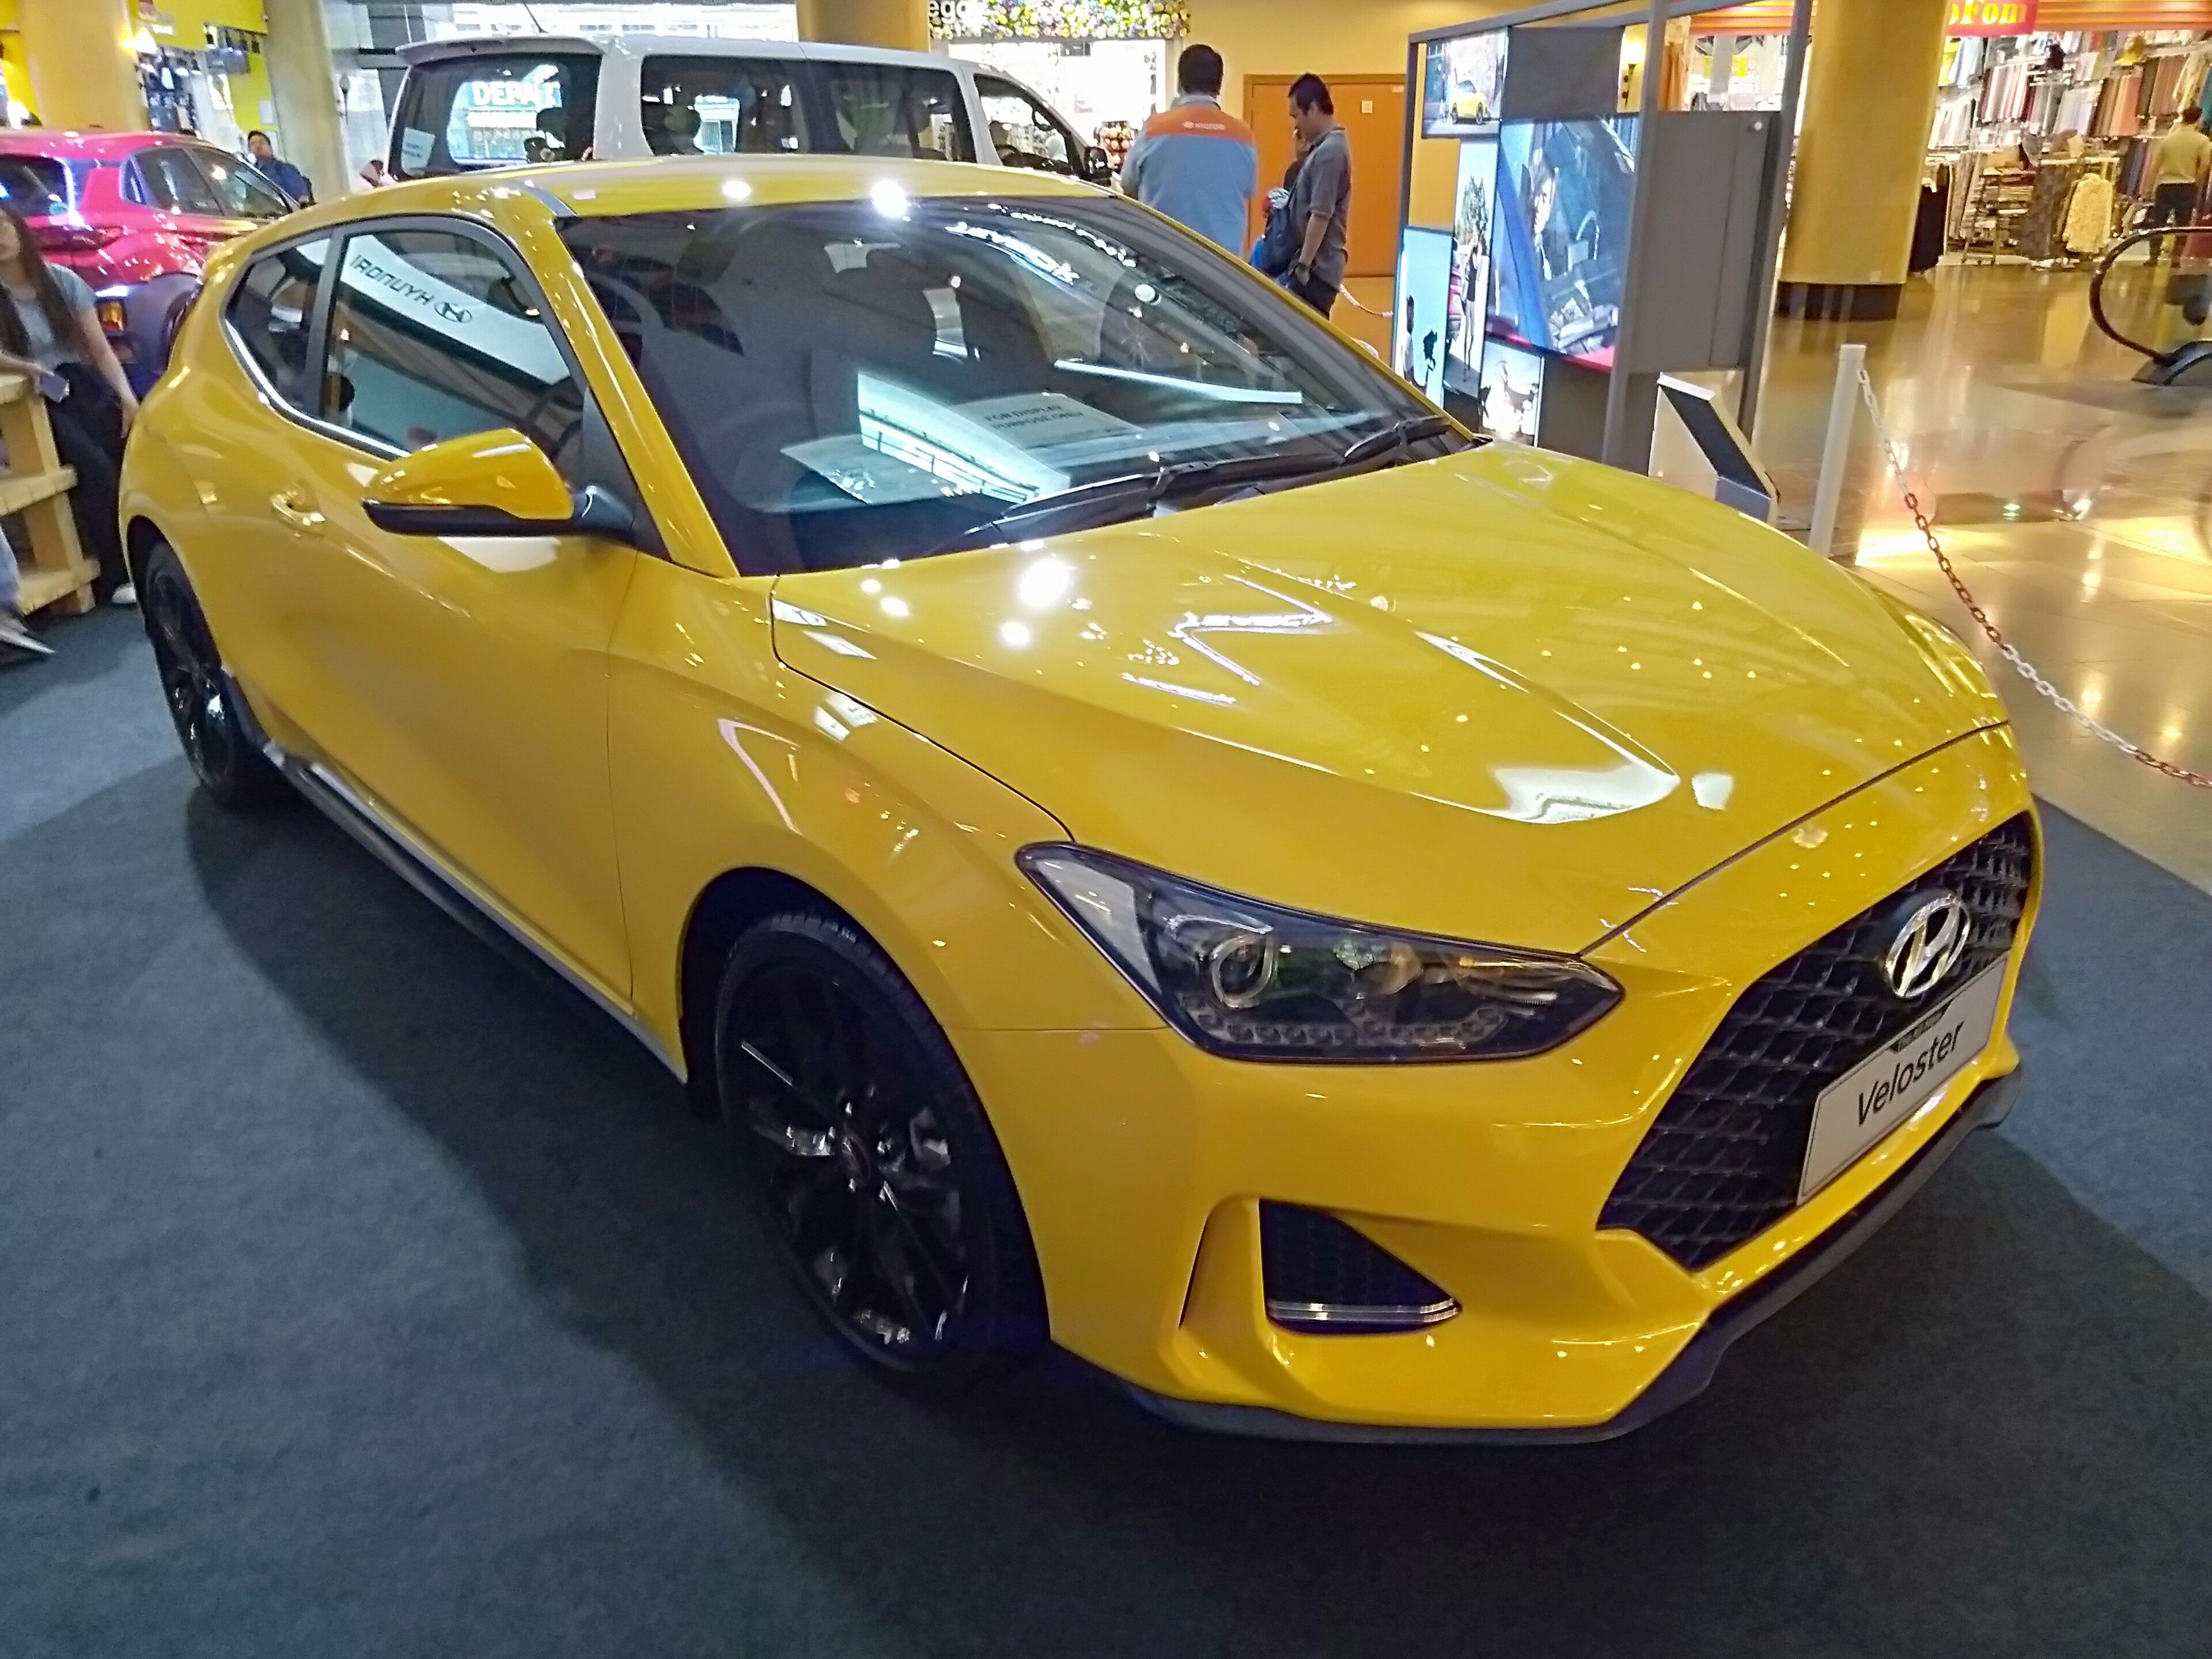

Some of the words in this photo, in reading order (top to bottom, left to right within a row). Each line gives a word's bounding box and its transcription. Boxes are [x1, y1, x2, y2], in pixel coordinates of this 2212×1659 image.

[984, 411, 1011, 421] FOR
[1012, 406, 1062, 417] DISPLAY
[991, 415, 1050, 430] PURPOSE
[1051, 411, 1084, 419] ONLY
[1858, 1020, 1964, 1127] Veloster
